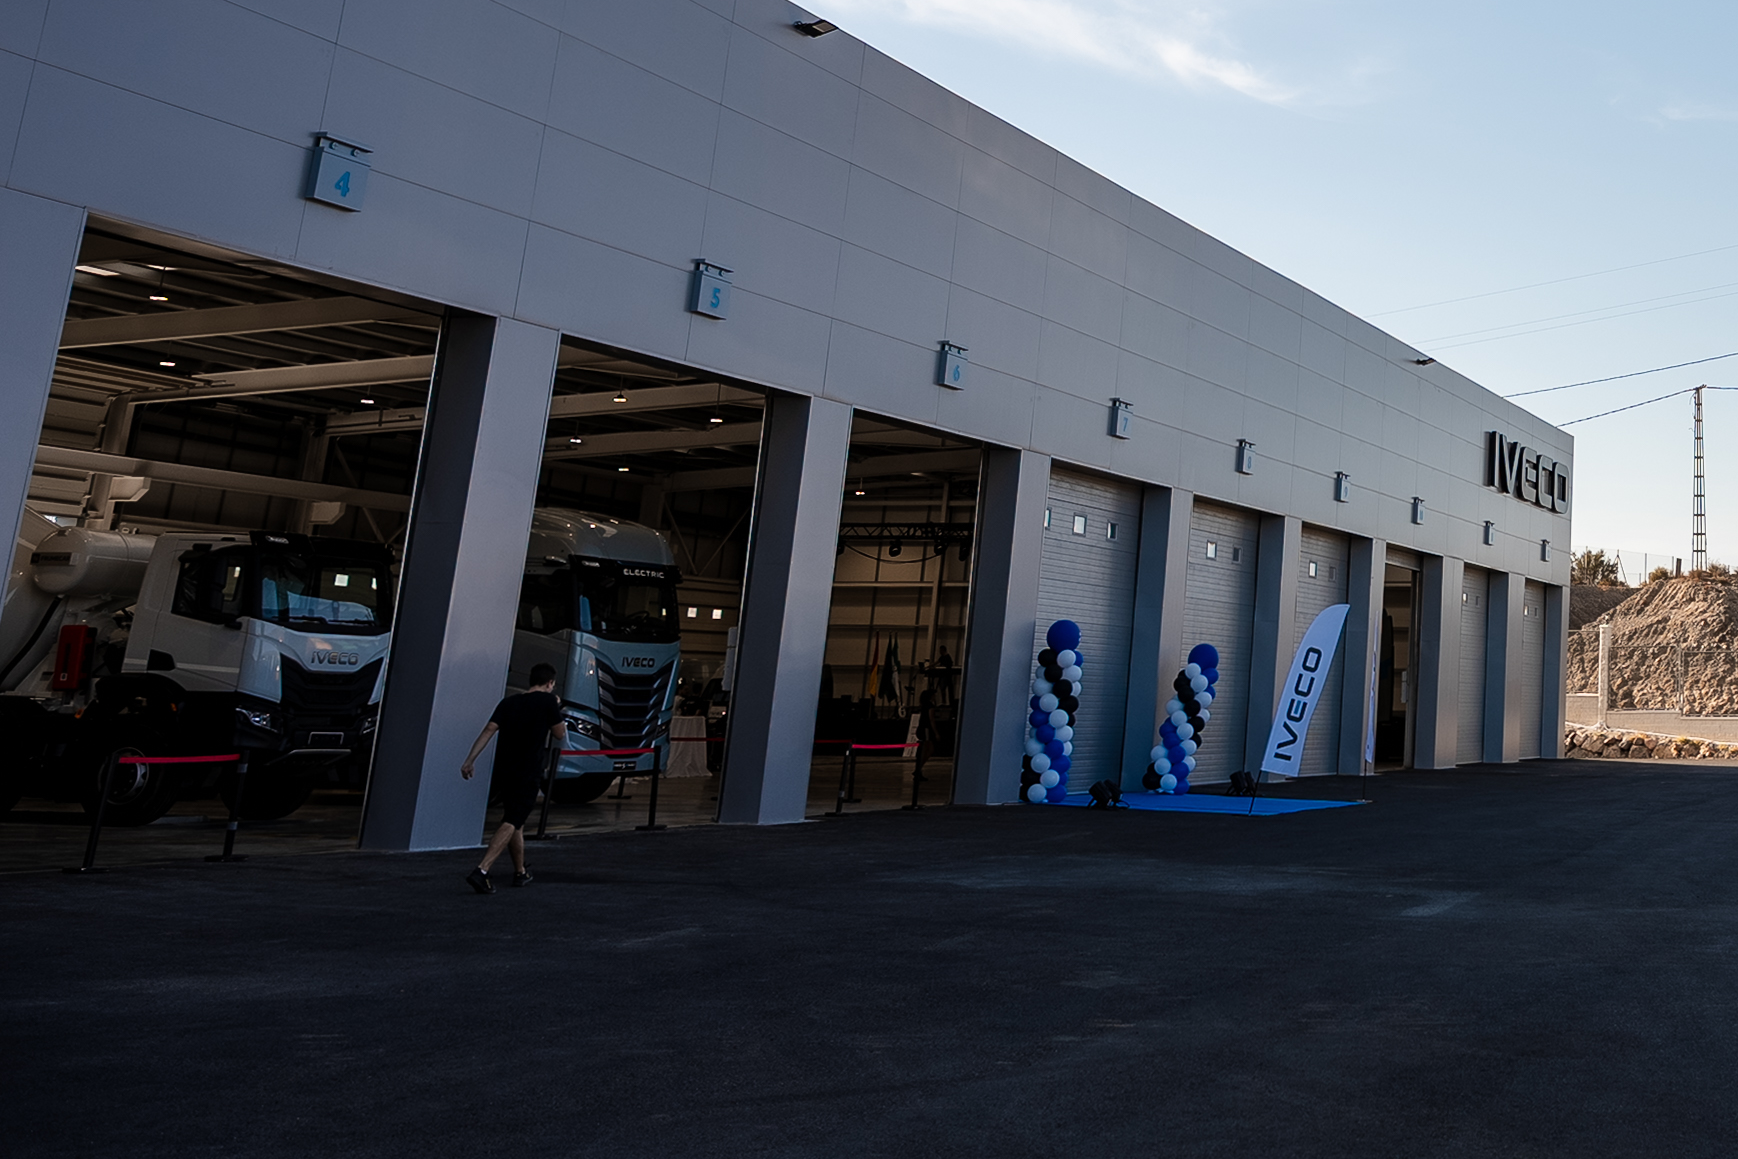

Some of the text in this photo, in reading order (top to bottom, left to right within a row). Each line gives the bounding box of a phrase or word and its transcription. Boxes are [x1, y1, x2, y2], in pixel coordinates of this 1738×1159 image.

[334, 171, 350, 198] 4
[710, 287, 722, 309] 5
[953, 364, 961, 382] 6
[1123, 417, 1129, 432] 7
[1492, 431, 1570, 515] IVECO
[622, 568, 665, 579] ELECTRIC
[311, 651, 359, 666] IVECO
[622, 656, 656, 669] IVECO
[1273, 646, 1323, 762] IVECO
